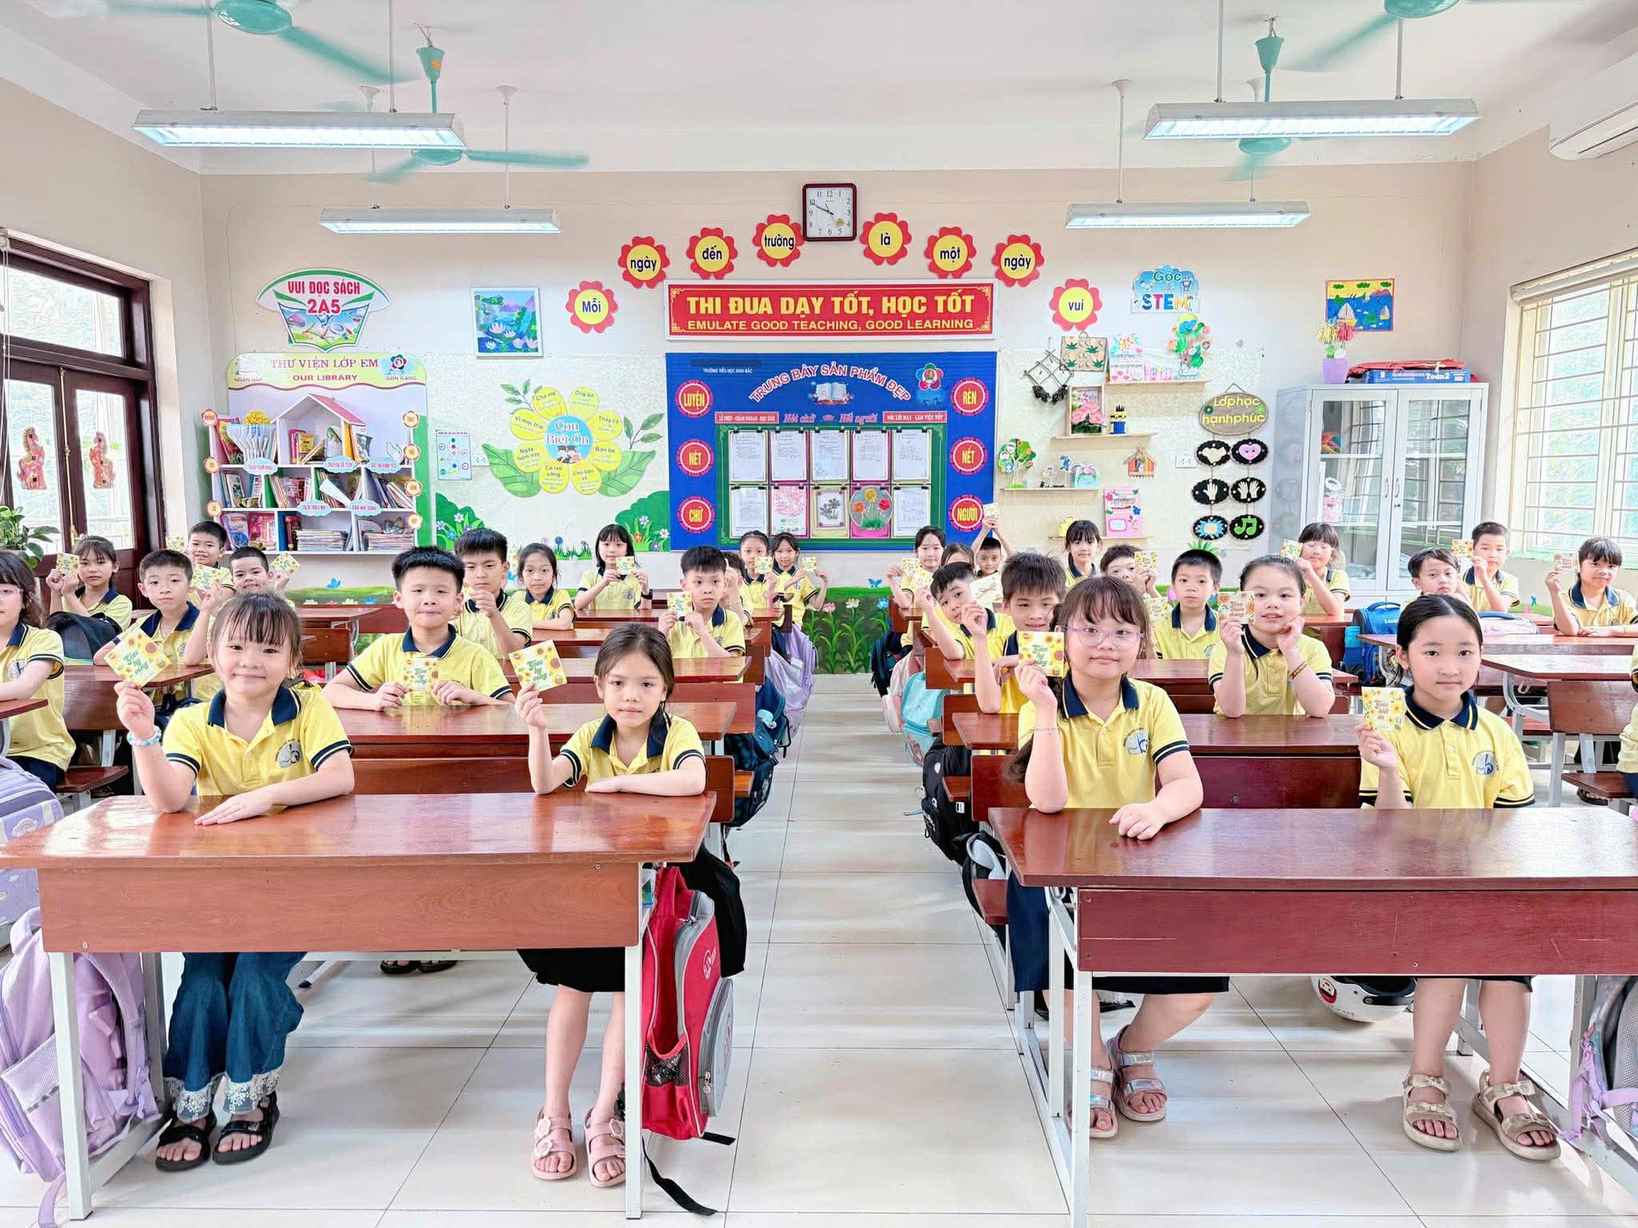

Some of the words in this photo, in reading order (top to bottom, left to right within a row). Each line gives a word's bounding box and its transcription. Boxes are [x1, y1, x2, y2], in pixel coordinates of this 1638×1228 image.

[582, 298, 601, 313] Mỗi
[630, 256, 657, 272] ngày
[702, 245, 722, 260] đến
[764, 234, 794, 250] trường
[880, 233, 891, 246] là
[940, 247, 961, 263] một
[1004, 253, 1031, 270] ngày
[1068, 299, 1084, 311] vui
[288, 281, 305, 295] VUI
[309, 281, 330, 298] ĐỌC
[333, 279, 360, 295] SÁCH
[307, 299, 341, 314] 2A5
[687, 297, 721, 315] THI
[728, 297, 773, 315] ĐUA
[781, 297, 824, 318] DẠY
[831, 291, 874, 316] TỐT,
[882, 295, 927, 318] HỌC
[934, 289, 975, 313] TỐT
[1142, 293, 1189, 311] STEM
[687, 320, 747, 330] EMULATE
[751, 320, 789, 330] GOOD
[792, 320, 862, 331] TEACHING,
[865, 319, 903, 330] GOOD
[907, 319, 974, 330] LEARNING
[272, 358, 296, 369] THƯ
[298, 355, 329, 371] VIỆN
[333, 356, 357, 369] LỚP
[360, 358, 379, 368] EM
[292, 374, 314, 382] OUR
[317, 374, 358, 382] LIBRARY
[790, 363, 819, 381] BÀY
[820, 361, 848, 377] SẢN
[886, 379, 912, 401] ĐẸP
[683, 391, 705, 410] LUYỆN
[962, 388, 977, 405] RÈN
[689, 506, 704, 523] CHỮ
